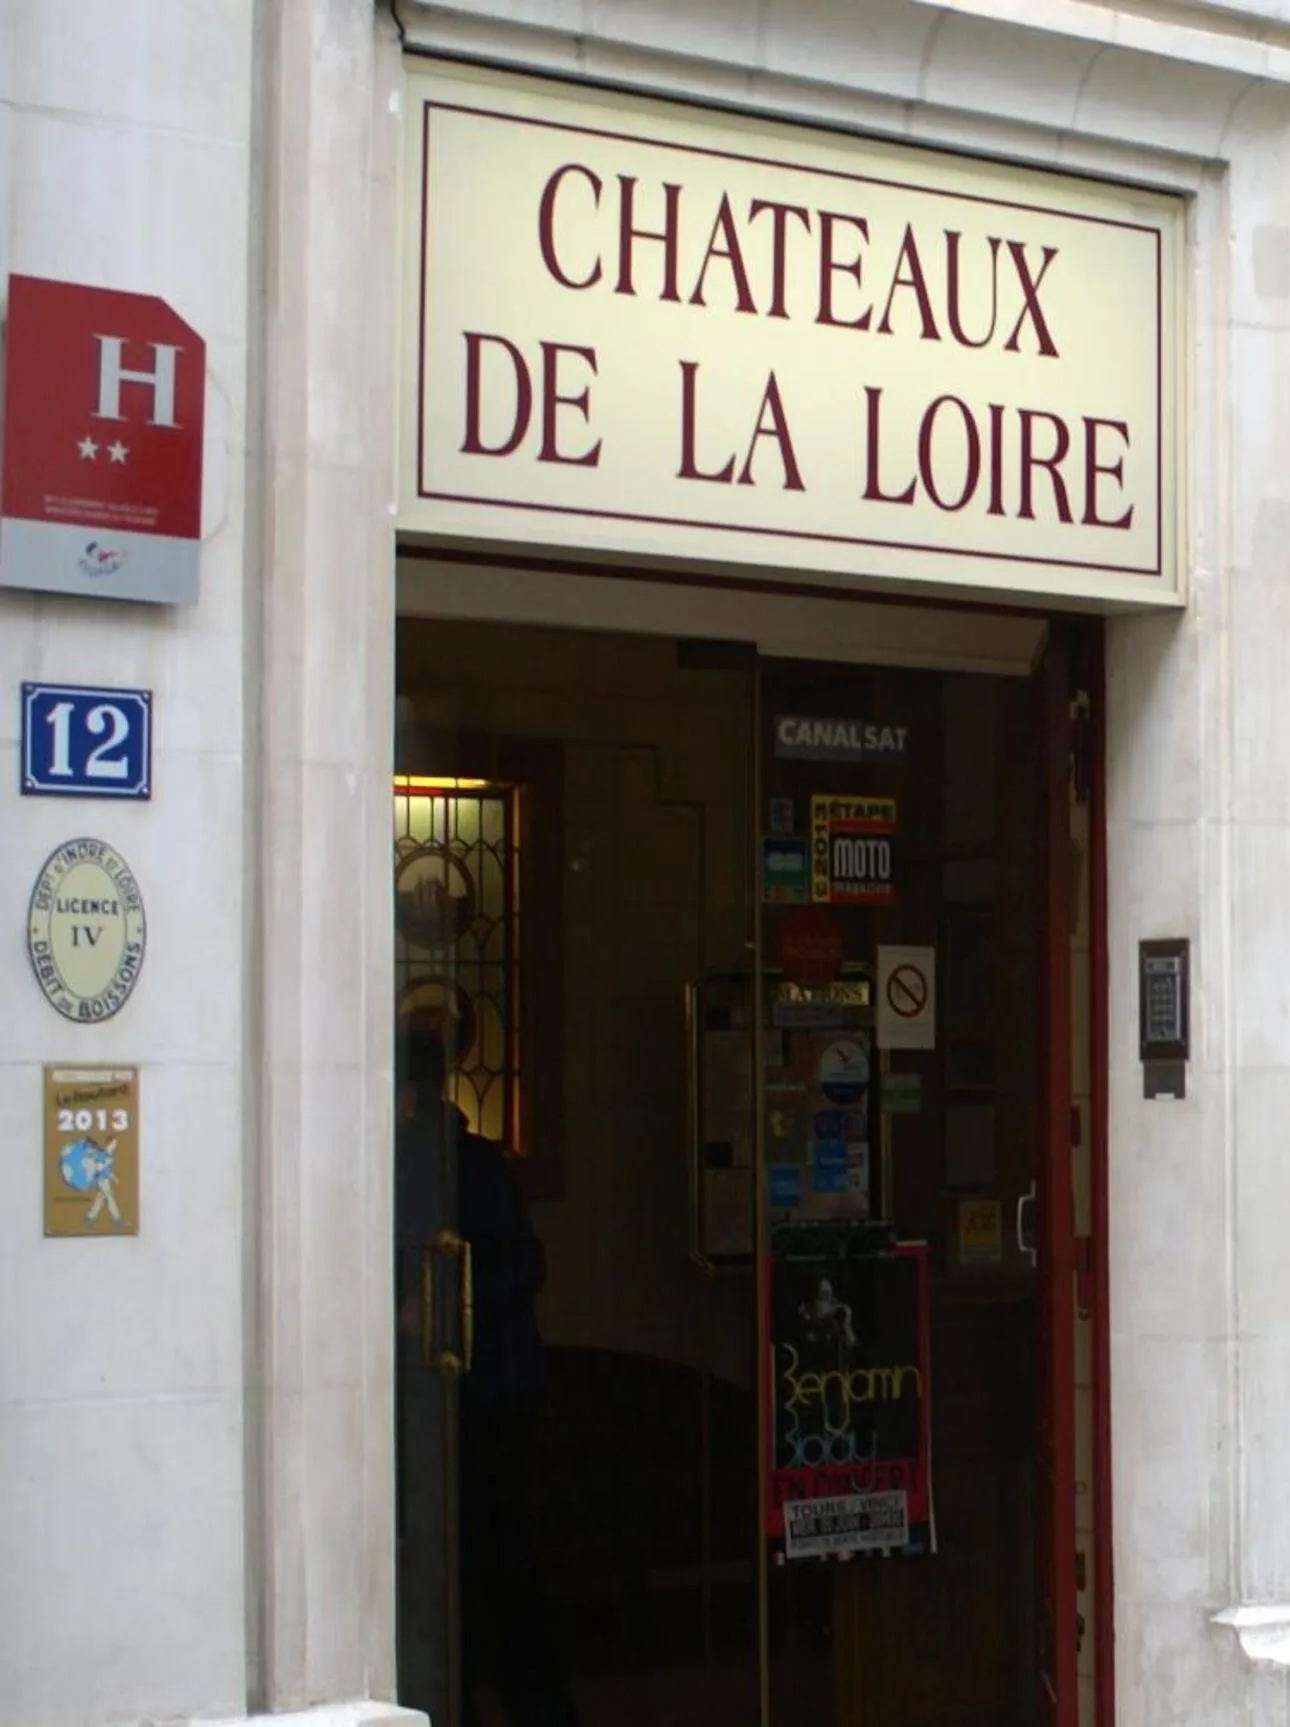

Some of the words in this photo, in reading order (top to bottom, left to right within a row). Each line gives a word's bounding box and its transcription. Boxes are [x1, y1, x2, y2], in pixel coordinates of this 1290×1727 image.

[538, 163, 1060, 358] CHATEAUX
[90, 331, 185, 430] H
[459, 331, 603, 467] DE
[676, 360, 807, 492] LA
[861, 385, 1135, 530] LOIRE
[46, 702, 129, 779] 12
[834, 836, 891, 880] MOTO
[56, 898, 120, 915] LICENCE
[71, 925, 104, 948] IV
[57, 1109, 128, 1131] 2013
[782, 1343, 922, 1435] Benjamin
